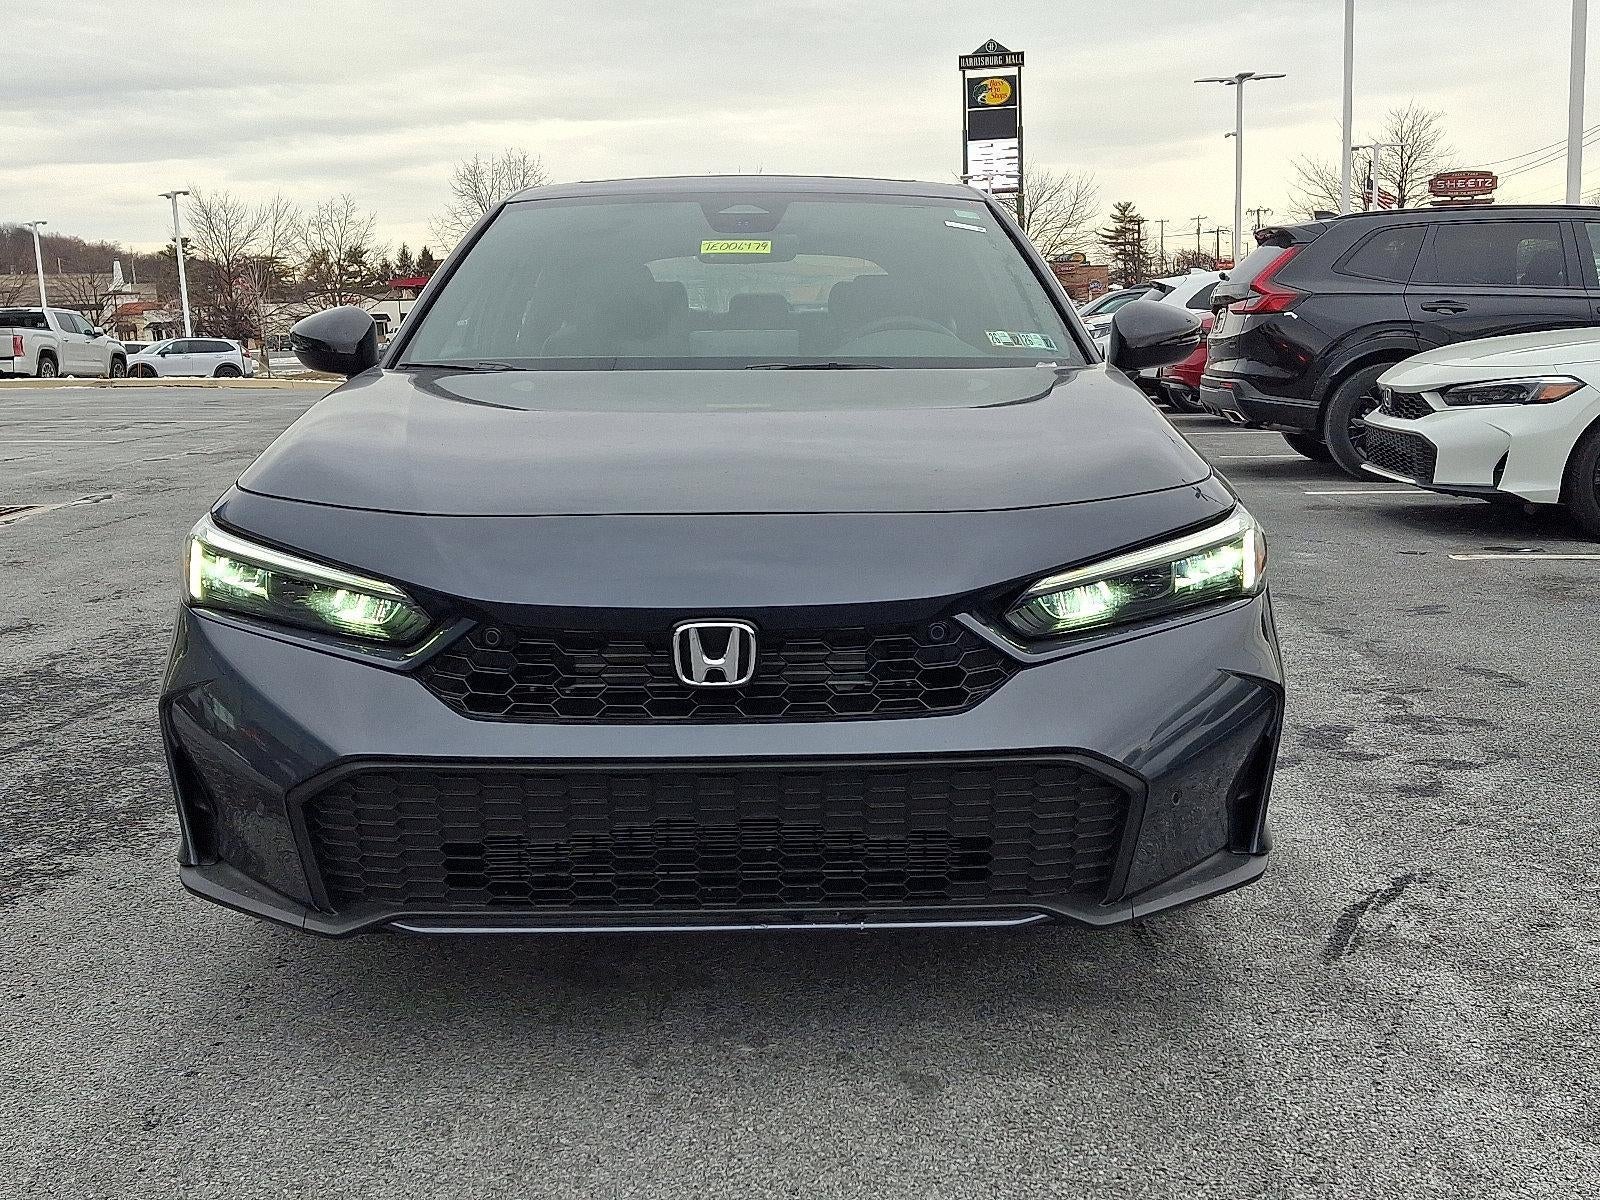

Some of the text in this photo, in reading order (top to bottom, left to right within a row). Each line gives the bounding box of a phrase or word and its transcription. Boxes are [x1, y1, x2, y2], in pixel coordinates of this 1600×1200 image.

[960, 54, 1023, 67] HARRISBURG MALL
[1437, 178, 1493, 189] SHEETZ
